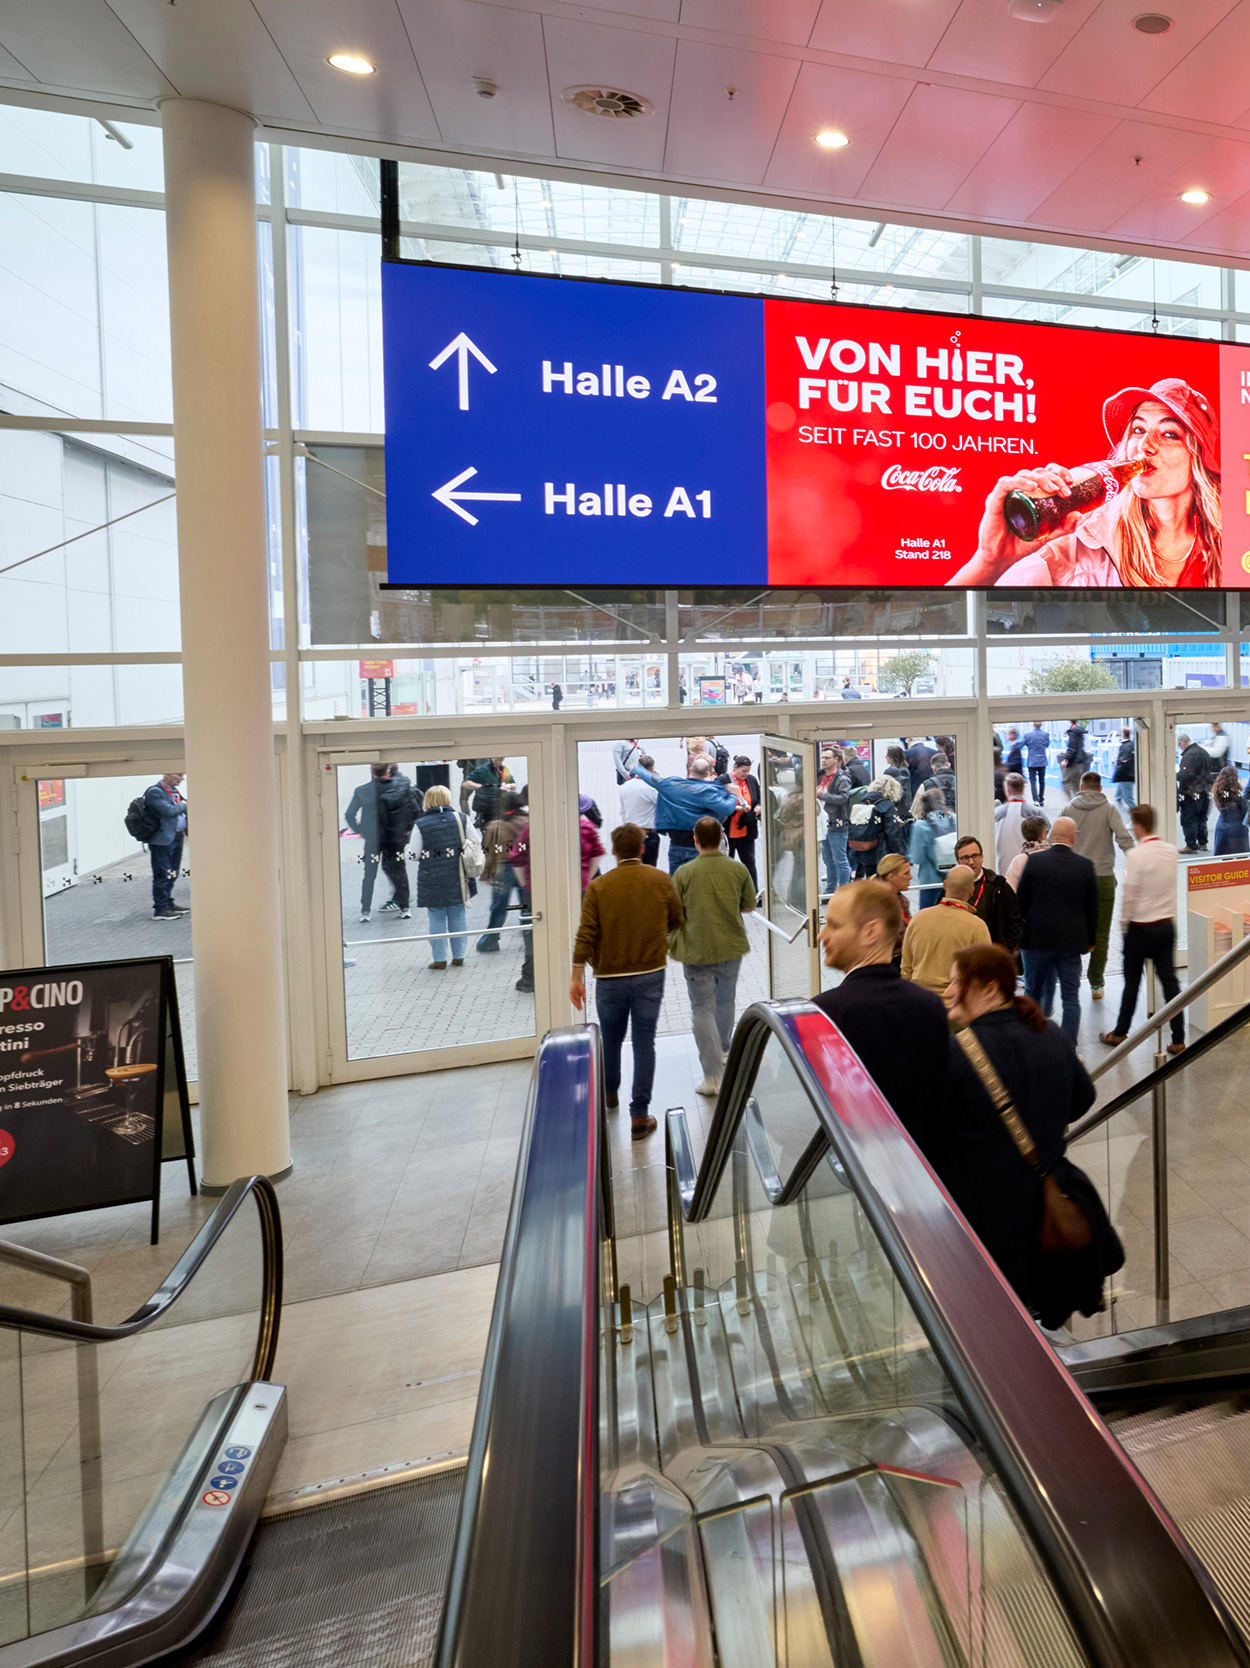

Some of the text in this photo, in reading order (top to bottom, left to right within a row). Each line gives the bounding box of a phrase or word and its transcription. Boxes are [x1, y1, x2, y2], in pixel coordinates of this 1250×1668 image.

[795, 336, 1034, 390] VON HIER,
[542, 360, 717, 403] Halle A2
[799, 377, 1037, 424] FÜR EUCH!
[798, 426, 1039, 455] SEIT FAST 100 JAHREN.
[881, 464, 962, 492] Coca-Cola
[544, 482, 711, 518] Halle A1
[901, 538, 946, 548] Halle A1
[895, 550, 951, 560] Stand 218
[1190, 873, 1222, 884] VISITOR
[1224, 870, 1249, 880] GUIDE
[0, 1022, 45, 1034] resso
[0, 1037, 29, 1052] tini
[8, 1079, 63, 1092] Siebträger
[14, 1101, 21, 1109] 8
[22, 1097, 63, 1108] Sekunden
